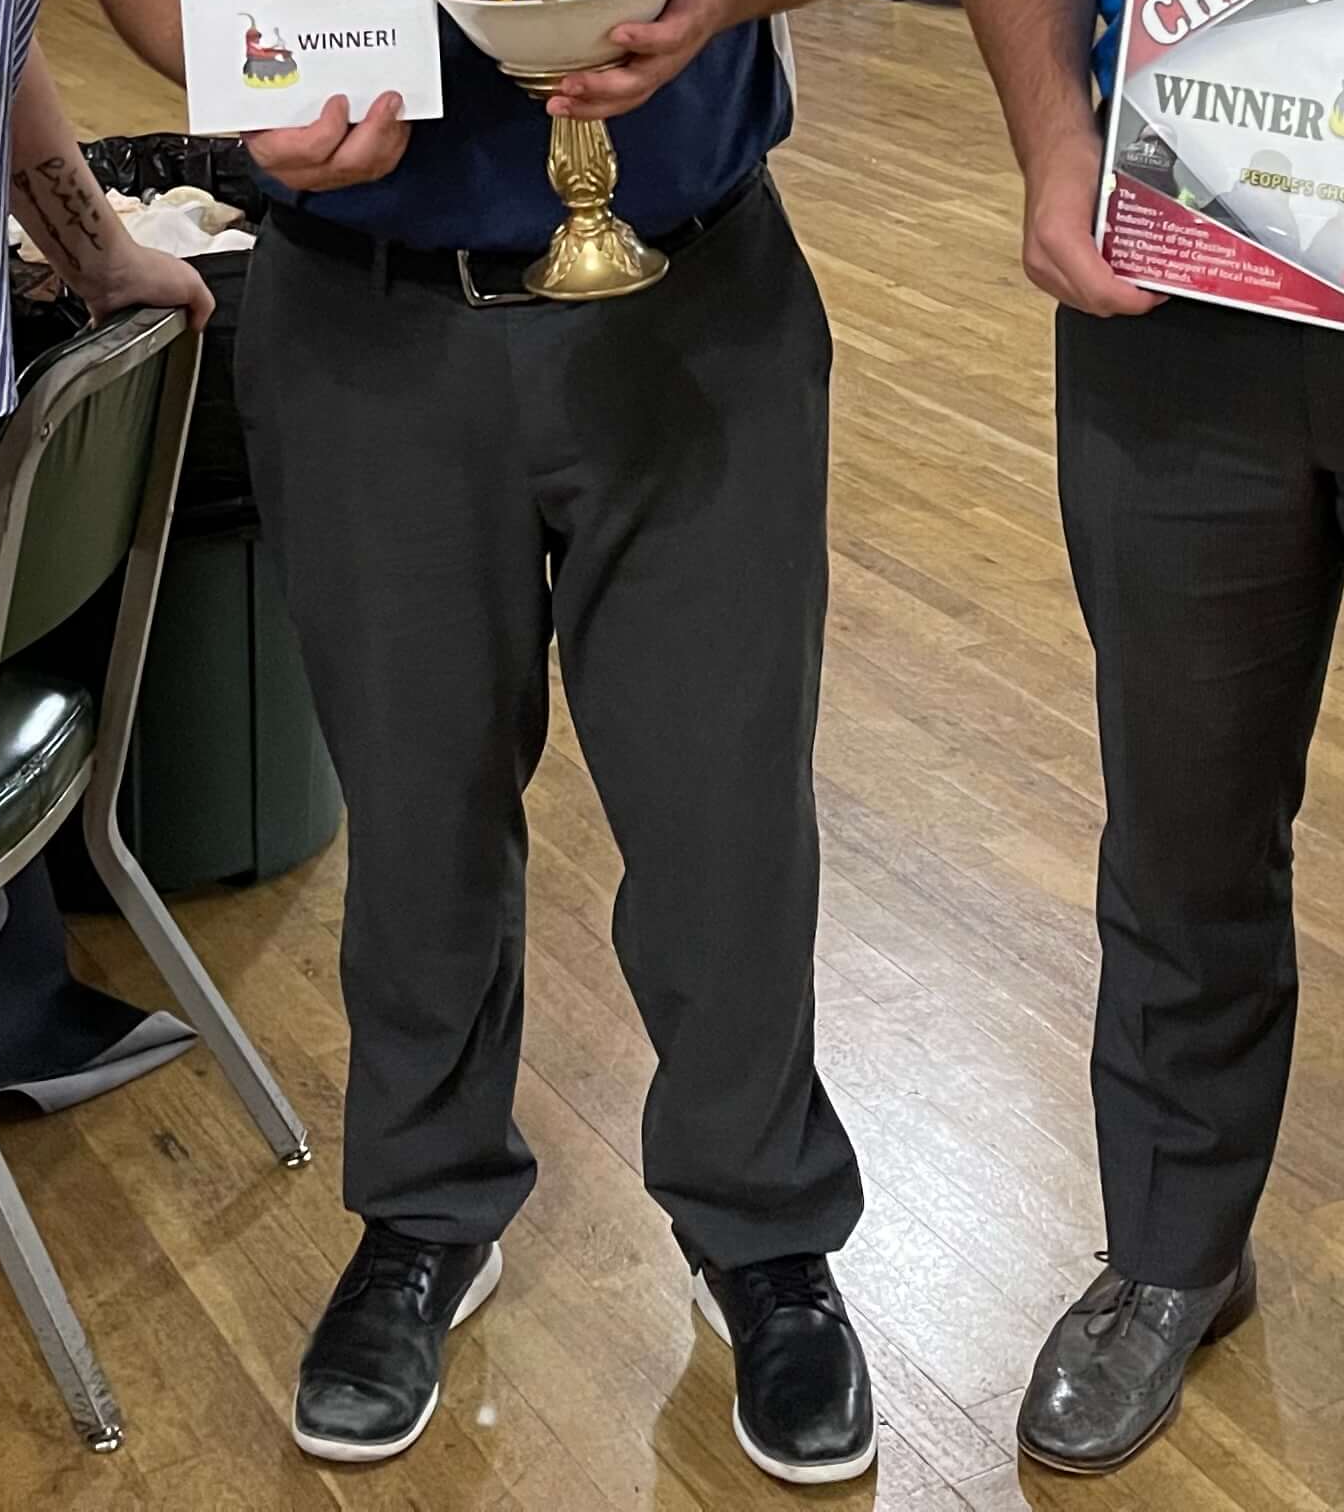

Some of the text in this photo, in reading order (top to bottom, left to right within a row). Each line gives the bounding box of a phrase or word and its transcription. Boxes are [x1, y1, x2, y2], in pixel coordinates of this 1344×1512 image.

[297, 28, 397, 51] WINNER!
[1153, 72, 1326, 141] WINNER
[1240, 167, 1314, 197] PEOPLE'S
[1118, 188, 1136, 201] The
[1117, 200, 1158, 217] Business
[1116, 212, 1155, 230] Industry
[1162, 221, 1209, 239] Education
[1112, 235, 1135, 249] Area
[1136, 239, 1178, 258] Chamber
[1178, 234, 1194, 248] the
